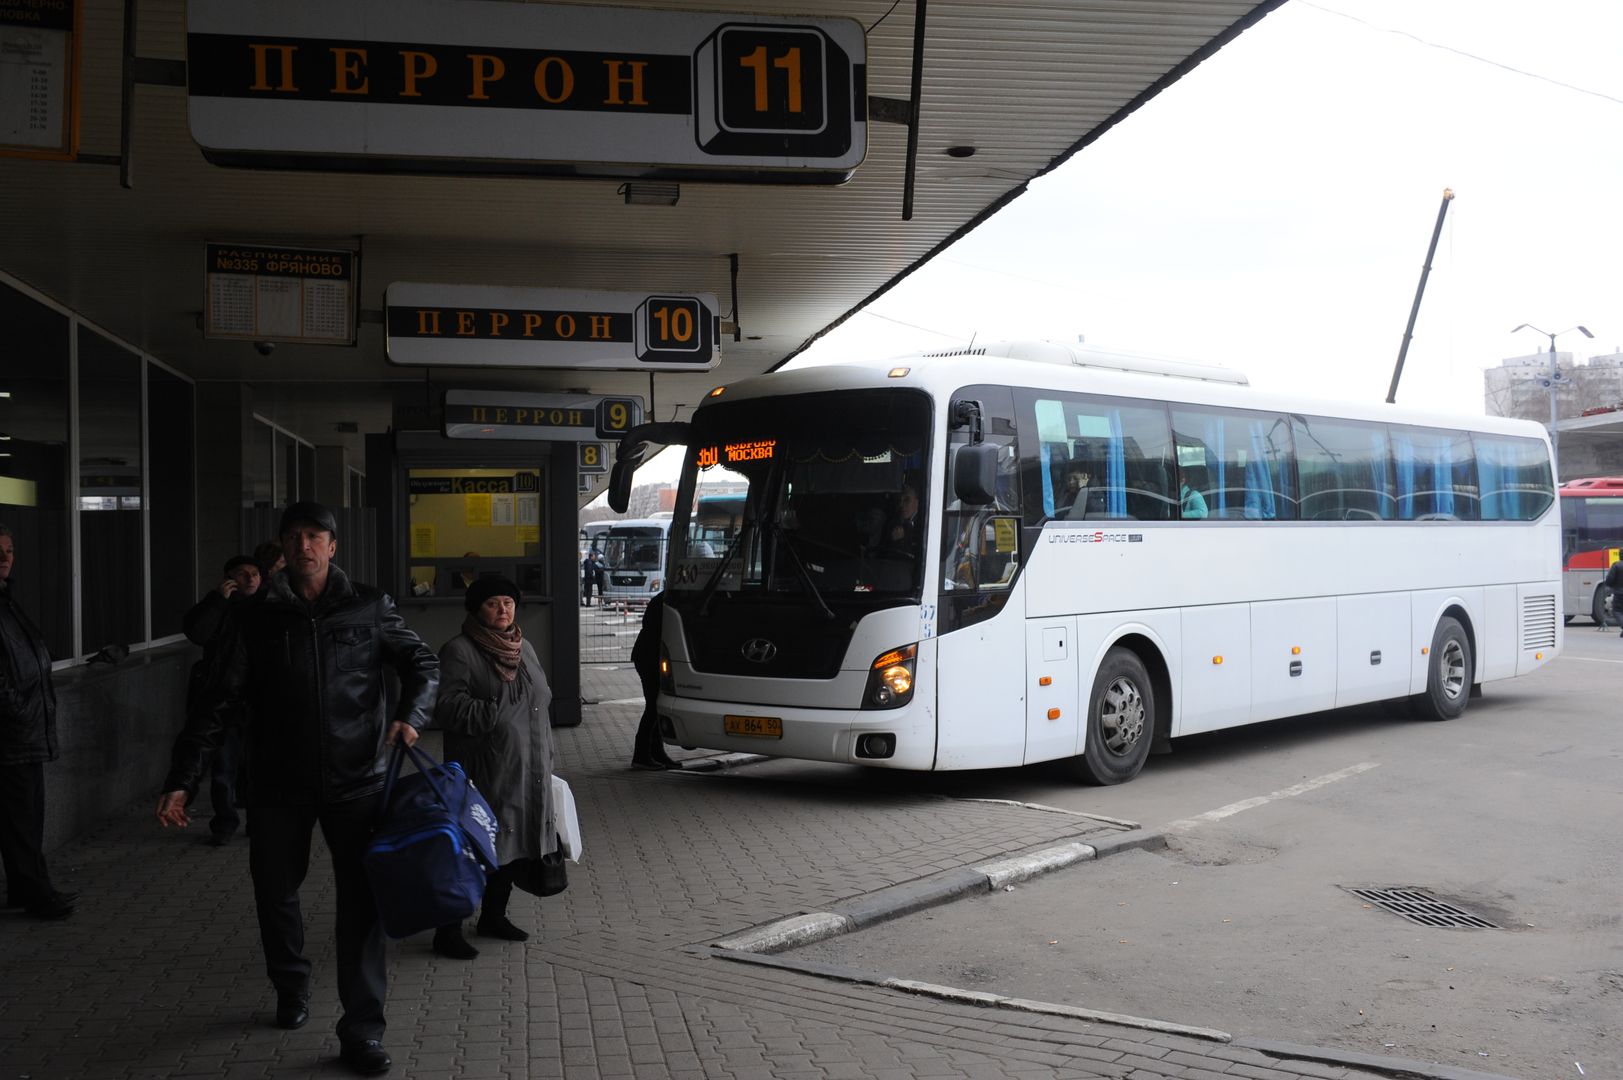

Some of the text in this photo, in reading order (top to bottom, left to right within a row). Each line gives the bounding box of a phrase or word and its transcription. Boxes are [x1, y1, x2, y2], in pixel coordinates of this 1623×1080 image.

[248, 43, 801, 112] ПЕРРОН 11
[217, 249, 341, 262] РАСПИСАНИЕ
[216, 257, 343, 276] №335 ФРЯНОВО
[416, 306, 693, 342] ПЕРРОН 10
[471, 403, 628, 430] ПЕРРОН 9
[584, 446, 598, 465] 8
[728, 446, 773, 462] МОСКВА
[451, 478, 509, 493] Касса
